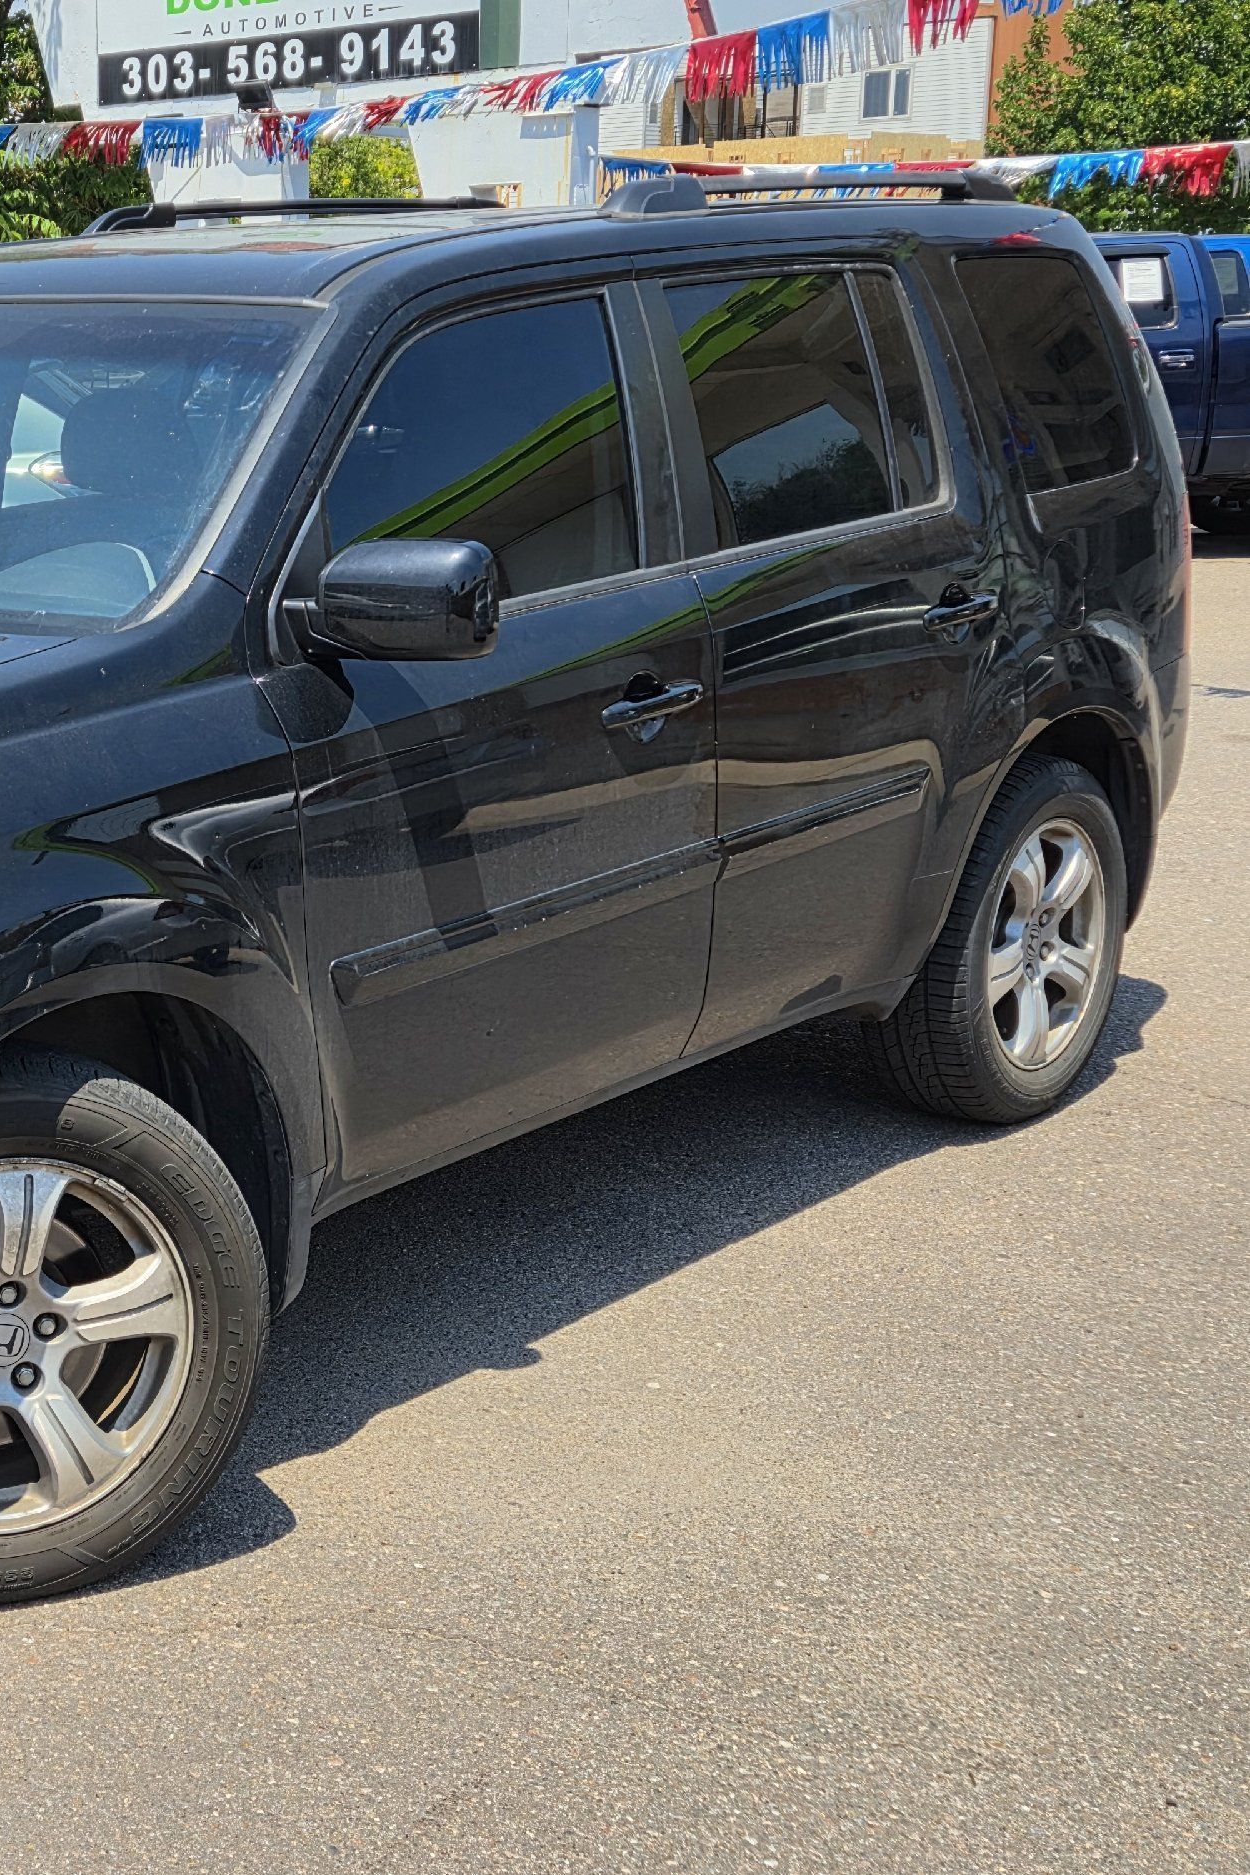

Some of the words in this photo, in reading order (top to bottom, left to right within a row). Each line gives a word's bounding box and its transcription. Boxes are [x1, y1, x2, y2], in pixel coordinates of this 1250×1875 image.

[202, 3, 374, 37] AUTOMOTIVE
[160, 1163, 240, 1289] EDGE
[129, 1309, 245, 1535] TOURING
